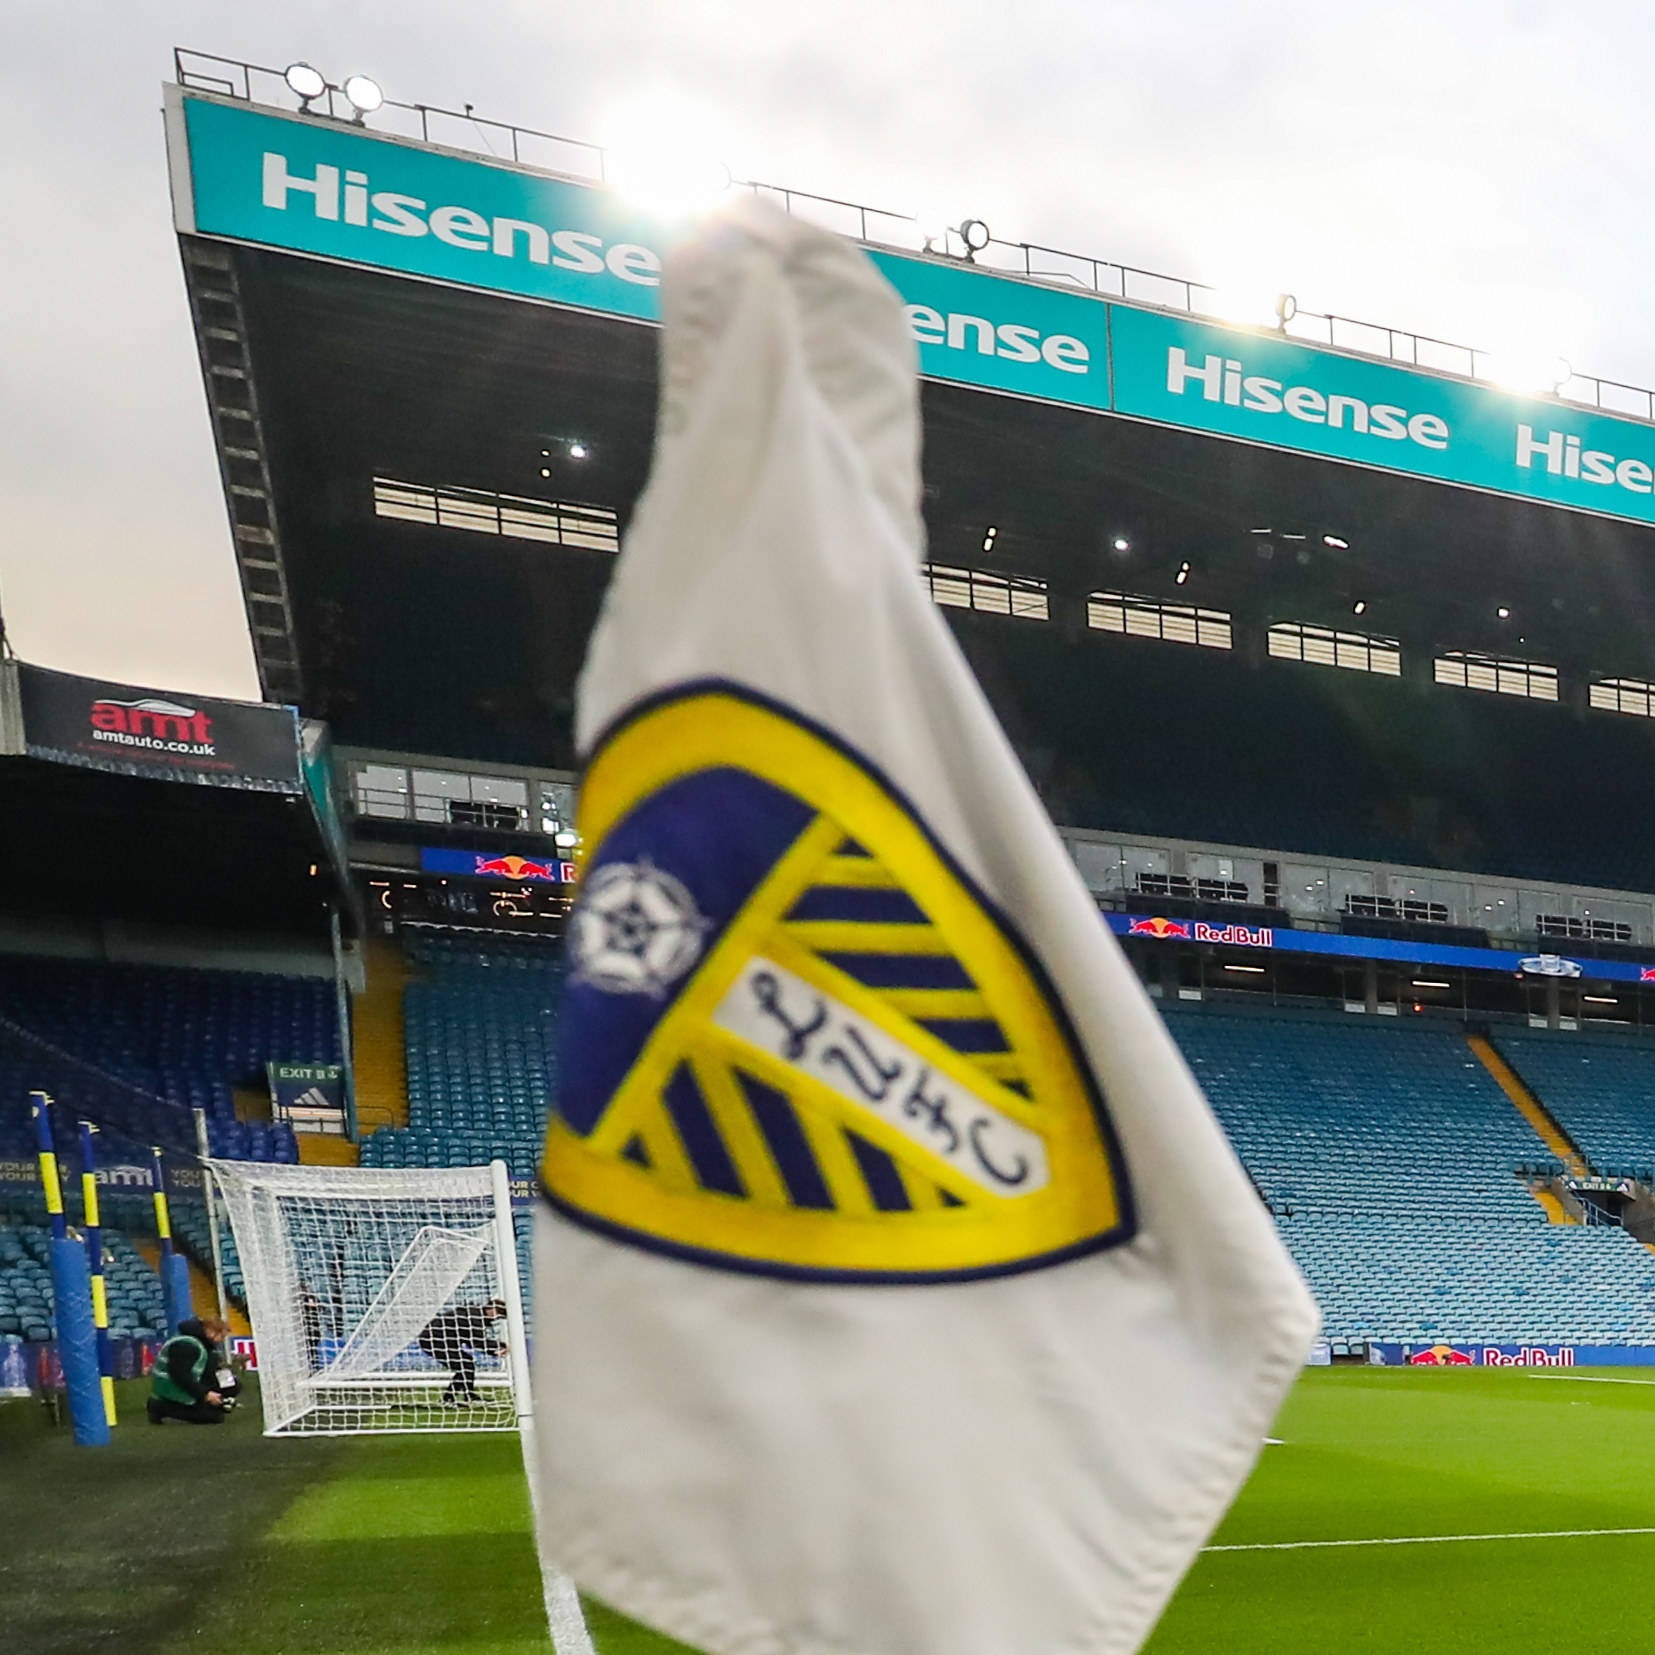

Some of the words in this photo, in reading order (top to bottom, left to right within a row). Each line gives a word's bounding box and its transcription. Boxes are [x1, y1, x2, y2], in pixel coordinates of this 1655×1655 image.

[261, 151, 661, 288] Hisense
[902, 303, 1090, 375] ense
[1166, 346, 1451, 450] Hisense
[90, 702, 214, 743] amt
[92, 730, 216, 756] amtauto.co.uk
[280, 1067, 312, 1079] EXIT
